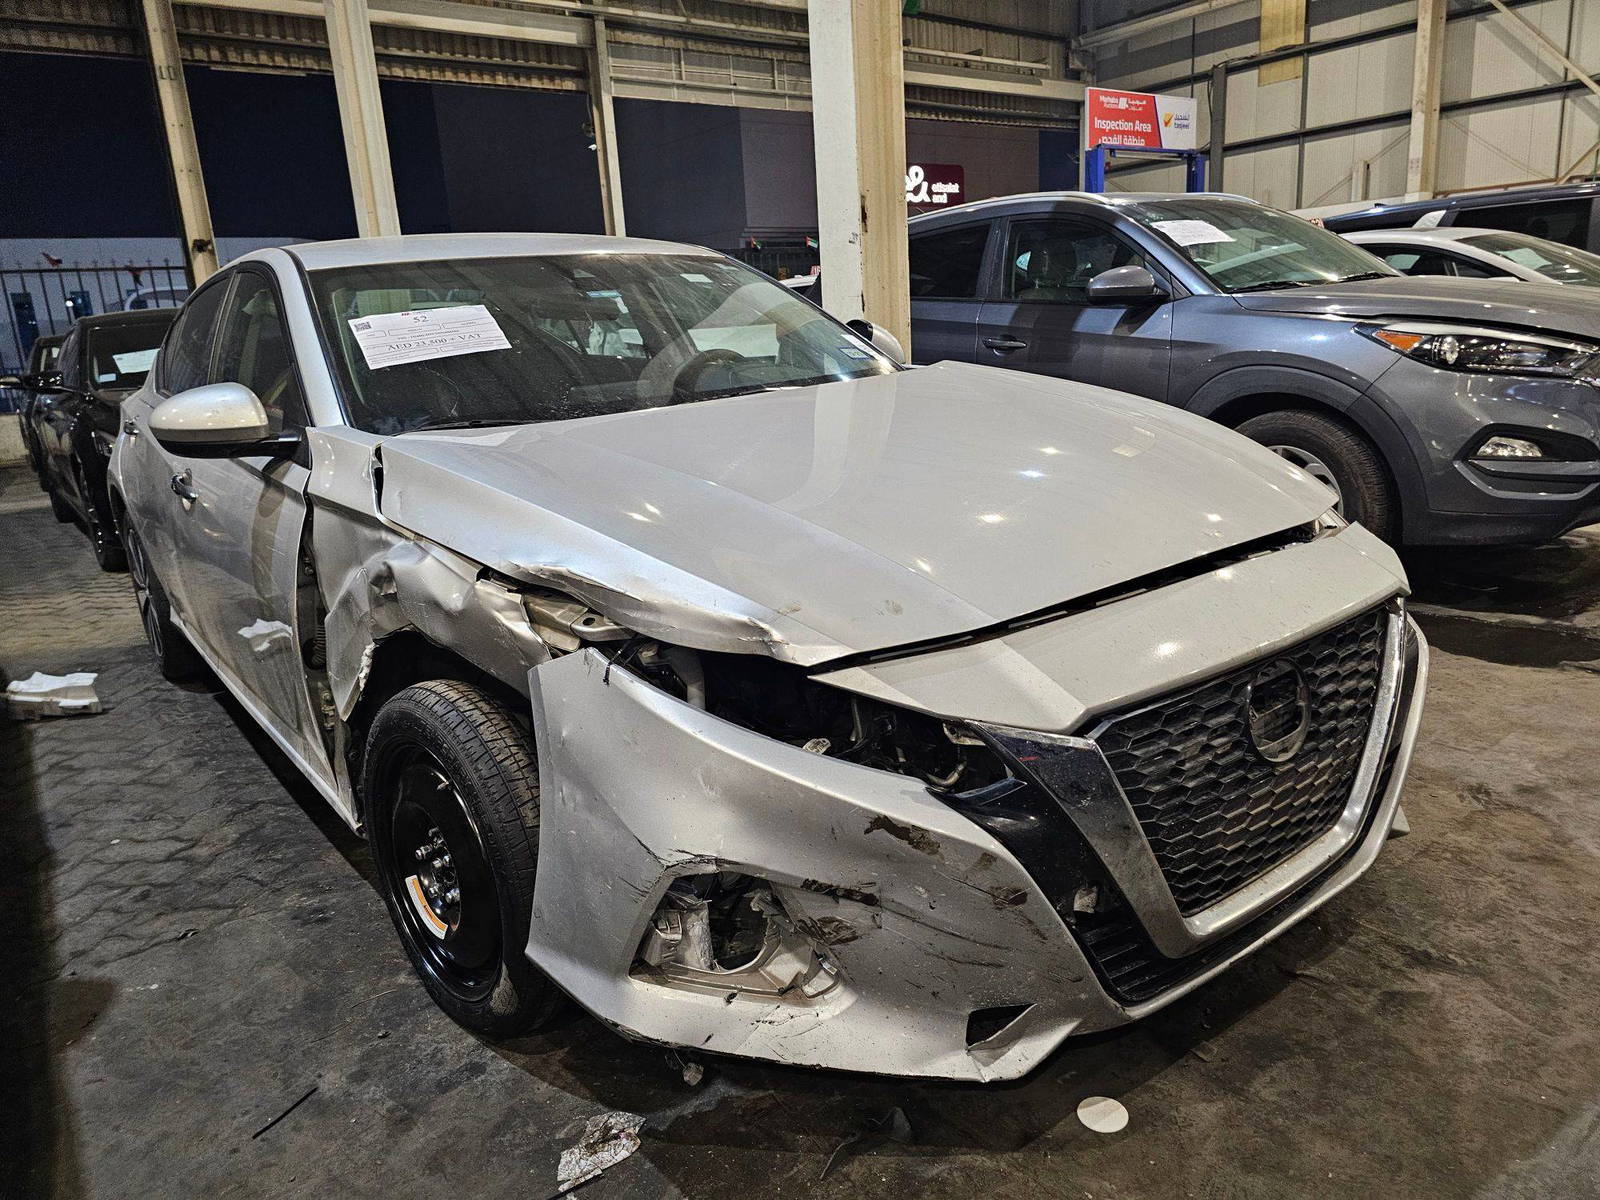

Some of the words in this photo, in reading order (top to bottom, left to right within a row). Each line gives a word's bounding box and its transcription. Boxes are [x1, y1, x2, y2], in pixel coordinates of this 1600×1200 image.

[1094, 116, 1133, 132] Inspection
[1134, 120, 1152, 132] Area
[413, 315, 430, 324] 52
[387, 341, 412, 351] AED
[458, 333, 481, 341] VAT
